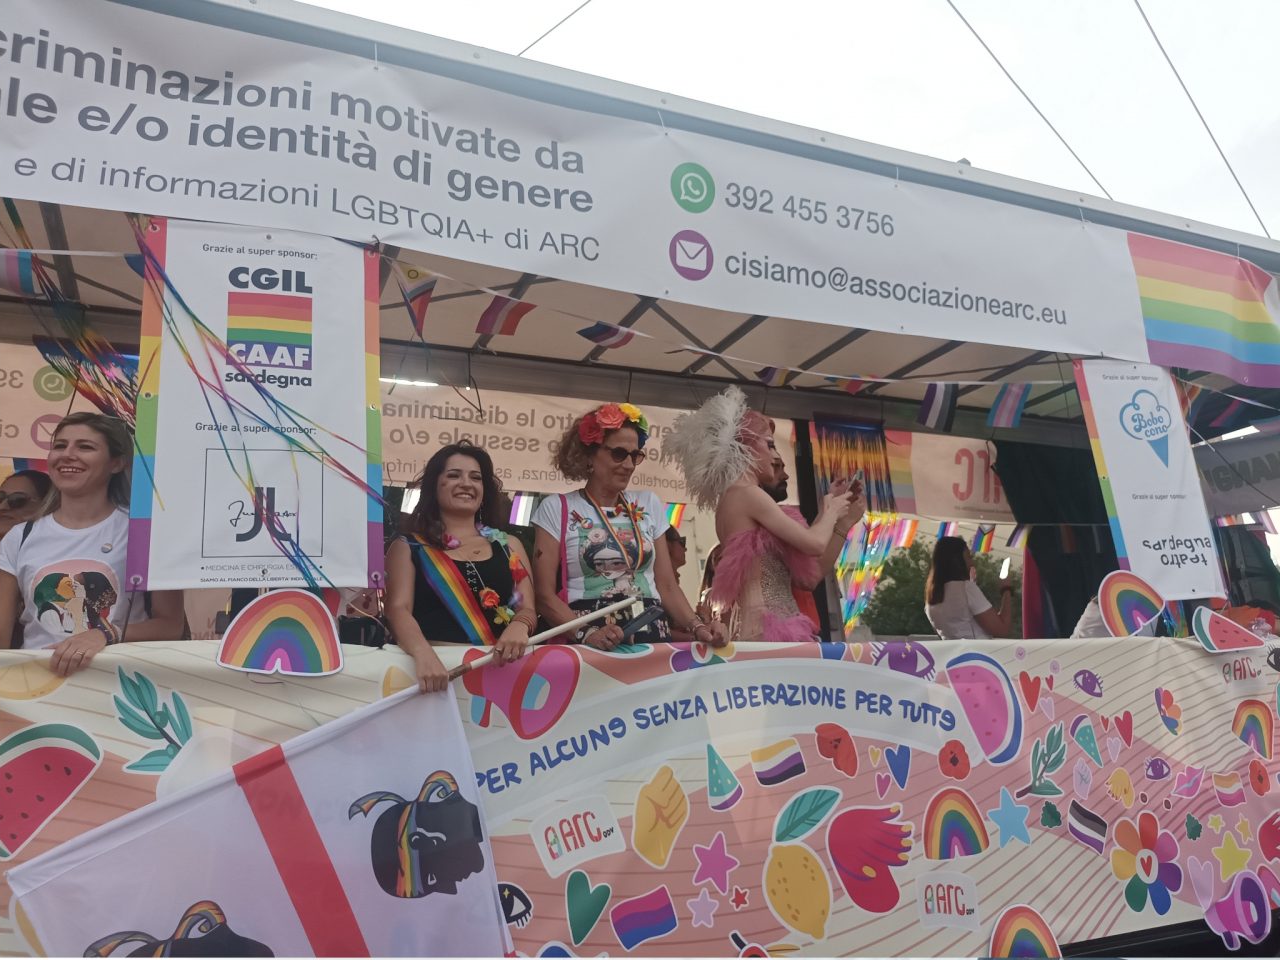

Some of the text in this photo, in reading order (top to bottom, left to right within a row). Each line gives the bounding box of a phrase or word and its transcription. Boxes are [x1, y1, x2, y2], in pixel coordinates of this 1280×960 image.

[329, 90, 521, 163] motivate
[534, 140, 585, 174] da
[77, 102, 169, 142] e/o
[188, 114, 378, 172] identità
[393, 149, 432, 186] di
[447, 168, 594, 213] genere
[14, 157, 600, 262] e di informazioni LGBTQIA+ di ARC
[724, 181, 896, 238] 392 455 3756
[202, 243, 318, 261] Grazie al super sponsor:
[228, 266, 313, 294] CGIL
[724, 250, 1068, 327] cisiamo@associazionearc.eu
[228, 343, 310, 368] CAAF
[224, 369, 313, 389] sardegna
[195, 422, 228, 432] Grazie
[243, 424, 271, 434] super
[1131, 411, 1164, 433] Bobo
[1144, 424, 1169, 438] cono
[1142, 534, 1211, 551] sardegna
[632, 694, 708, 730] SENZA
[712, 682, 846, 713] LIBERAZIONE
[854, 689, 892, 717] PER
